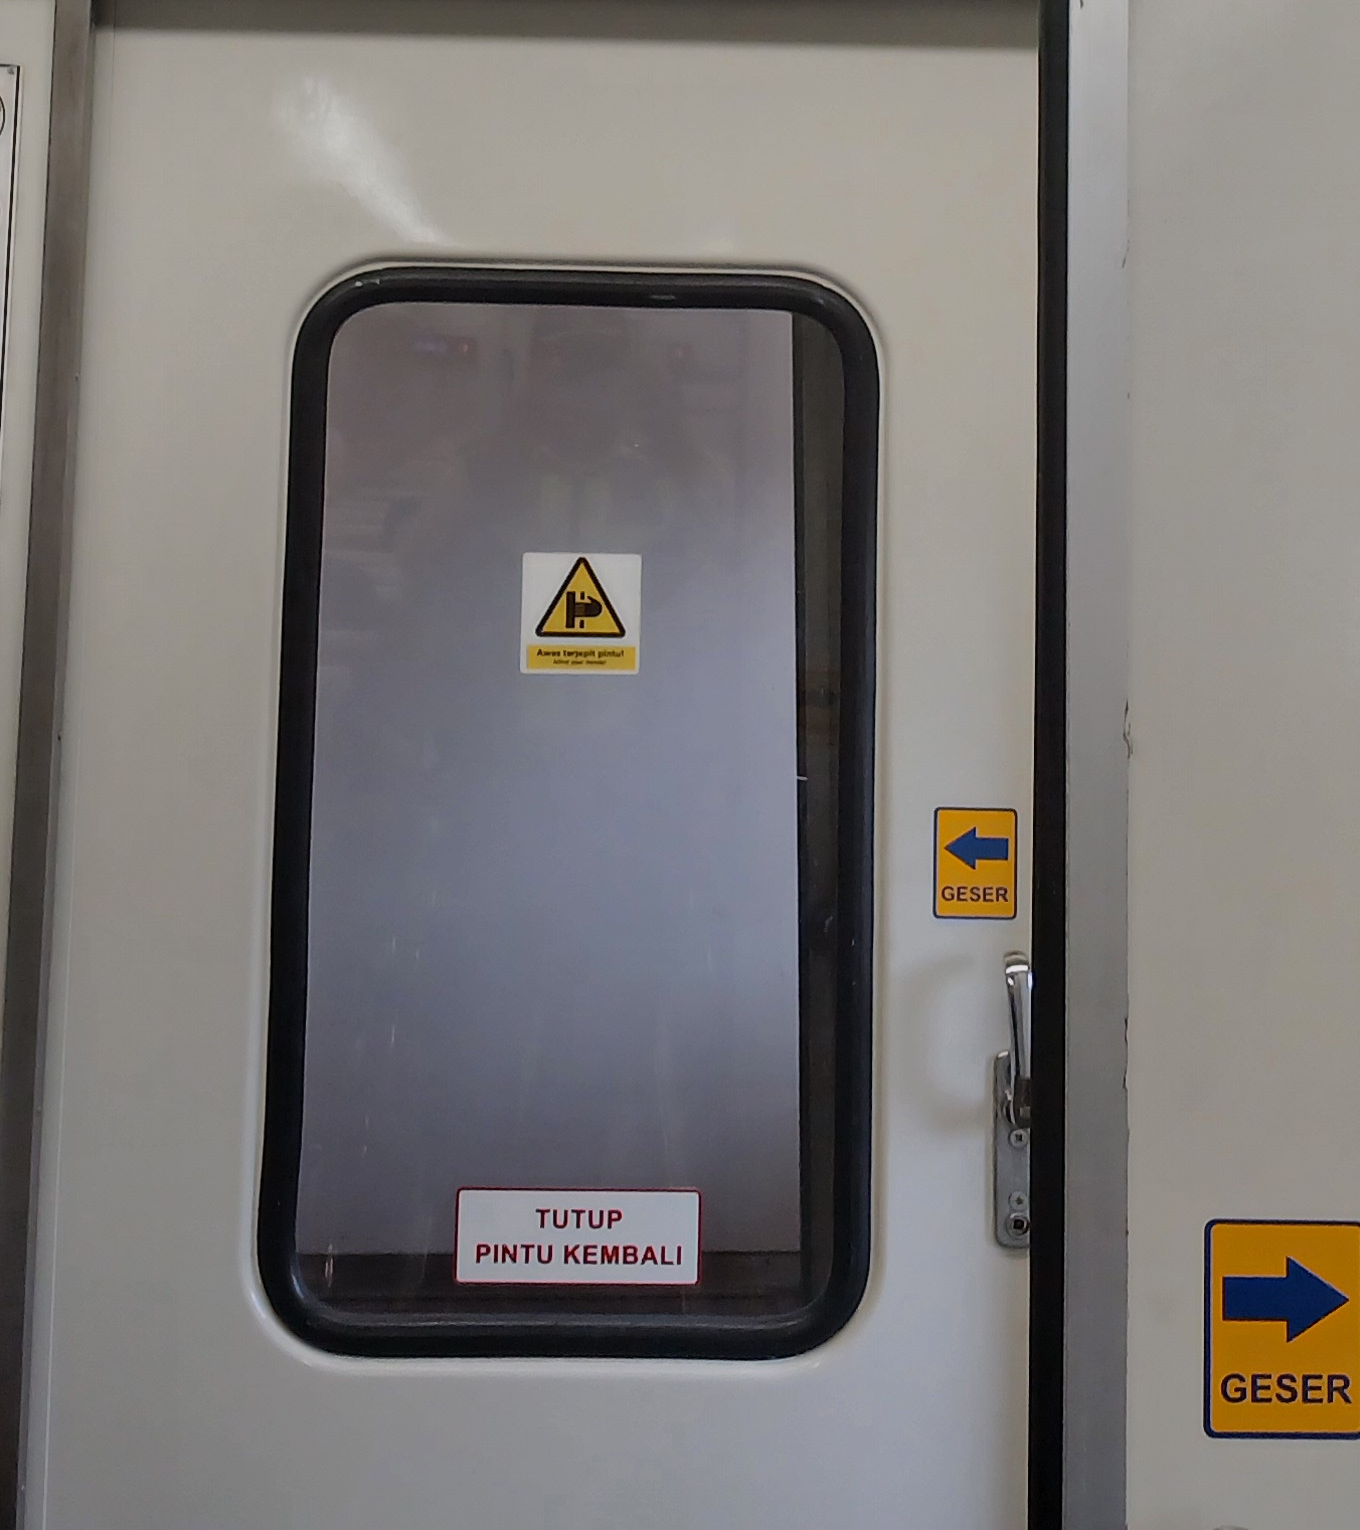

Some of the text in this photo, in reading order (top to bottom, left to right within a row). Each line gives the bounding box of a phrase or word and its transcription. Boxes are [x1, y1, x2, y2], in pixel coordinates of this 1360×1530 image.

[941, 886, 1008, 902] GESER
[535, 1209, 623, 1229] TUTUP
[476, 1244, 682, 1265] PINTU KEMBALI
[1221, 1373, 1352, 1404] GESER
